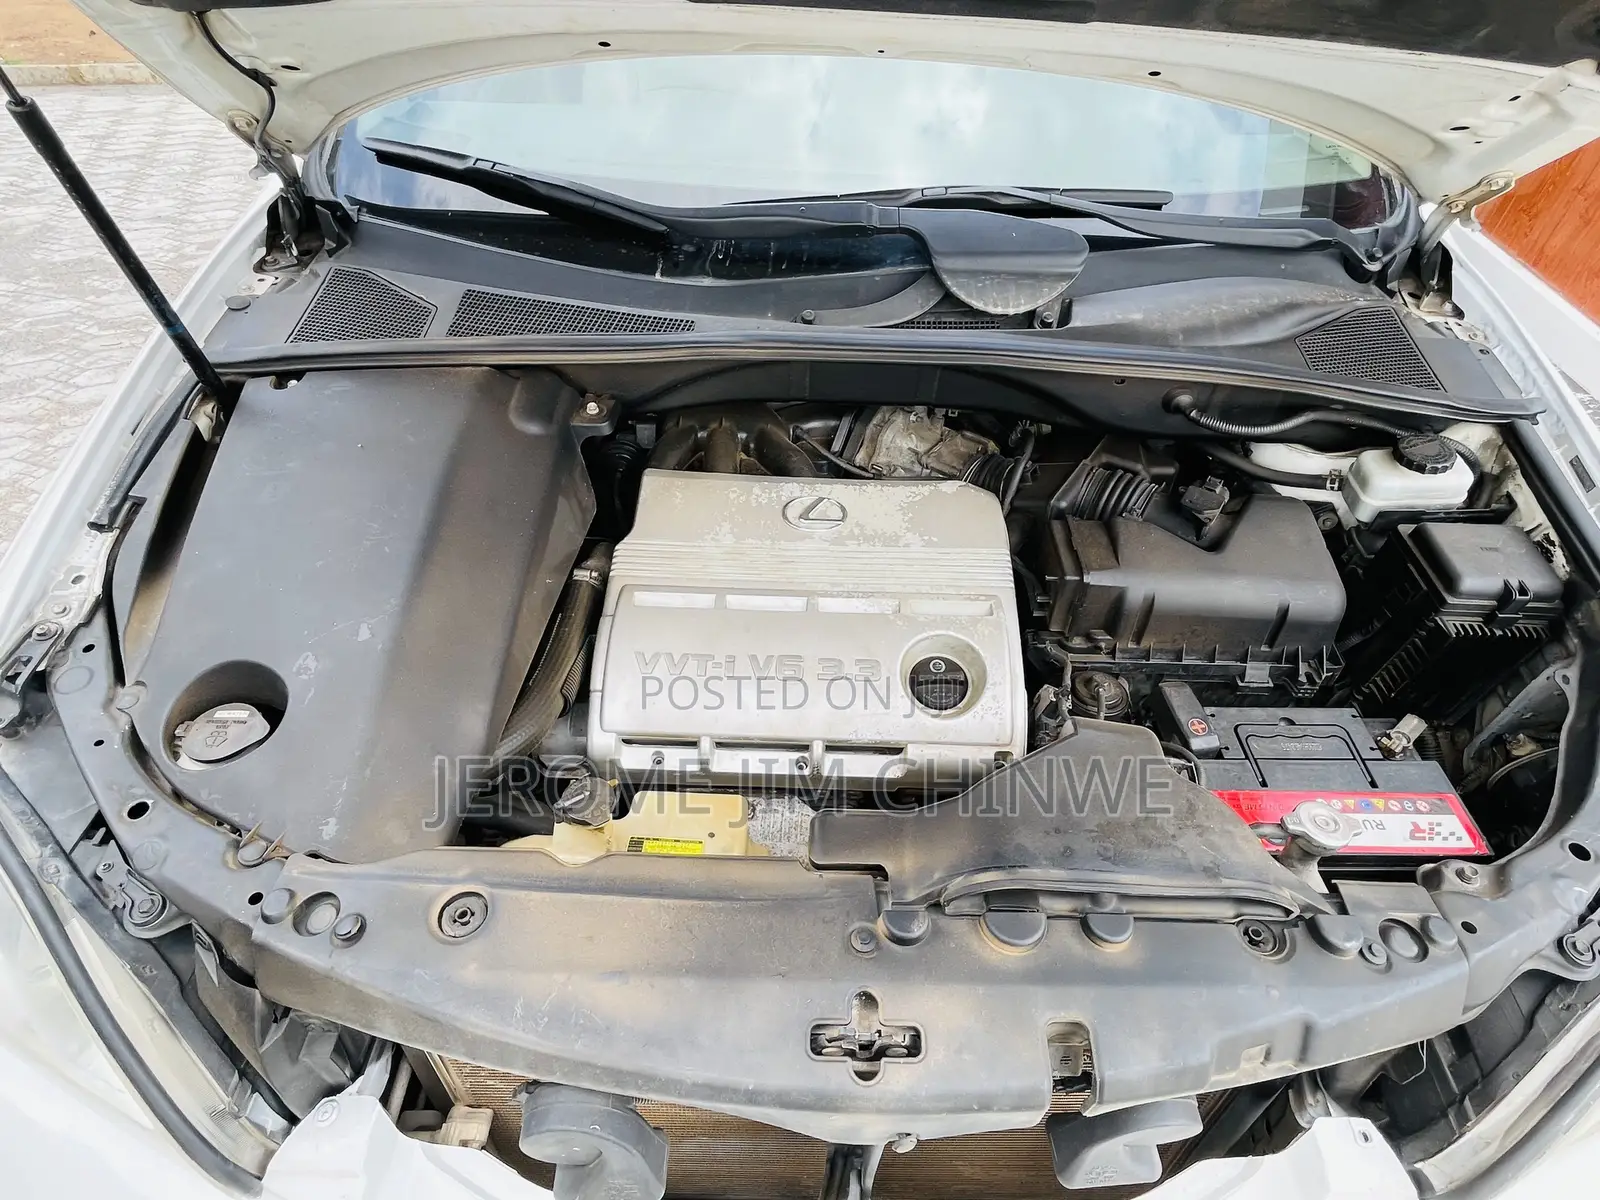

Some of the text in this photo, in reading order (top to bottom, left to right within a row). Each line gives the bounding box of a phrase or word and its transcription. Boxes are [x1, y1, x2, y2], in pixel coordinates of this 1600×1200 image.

[634, 651, 882, 682] VVT-i V6 3.3
